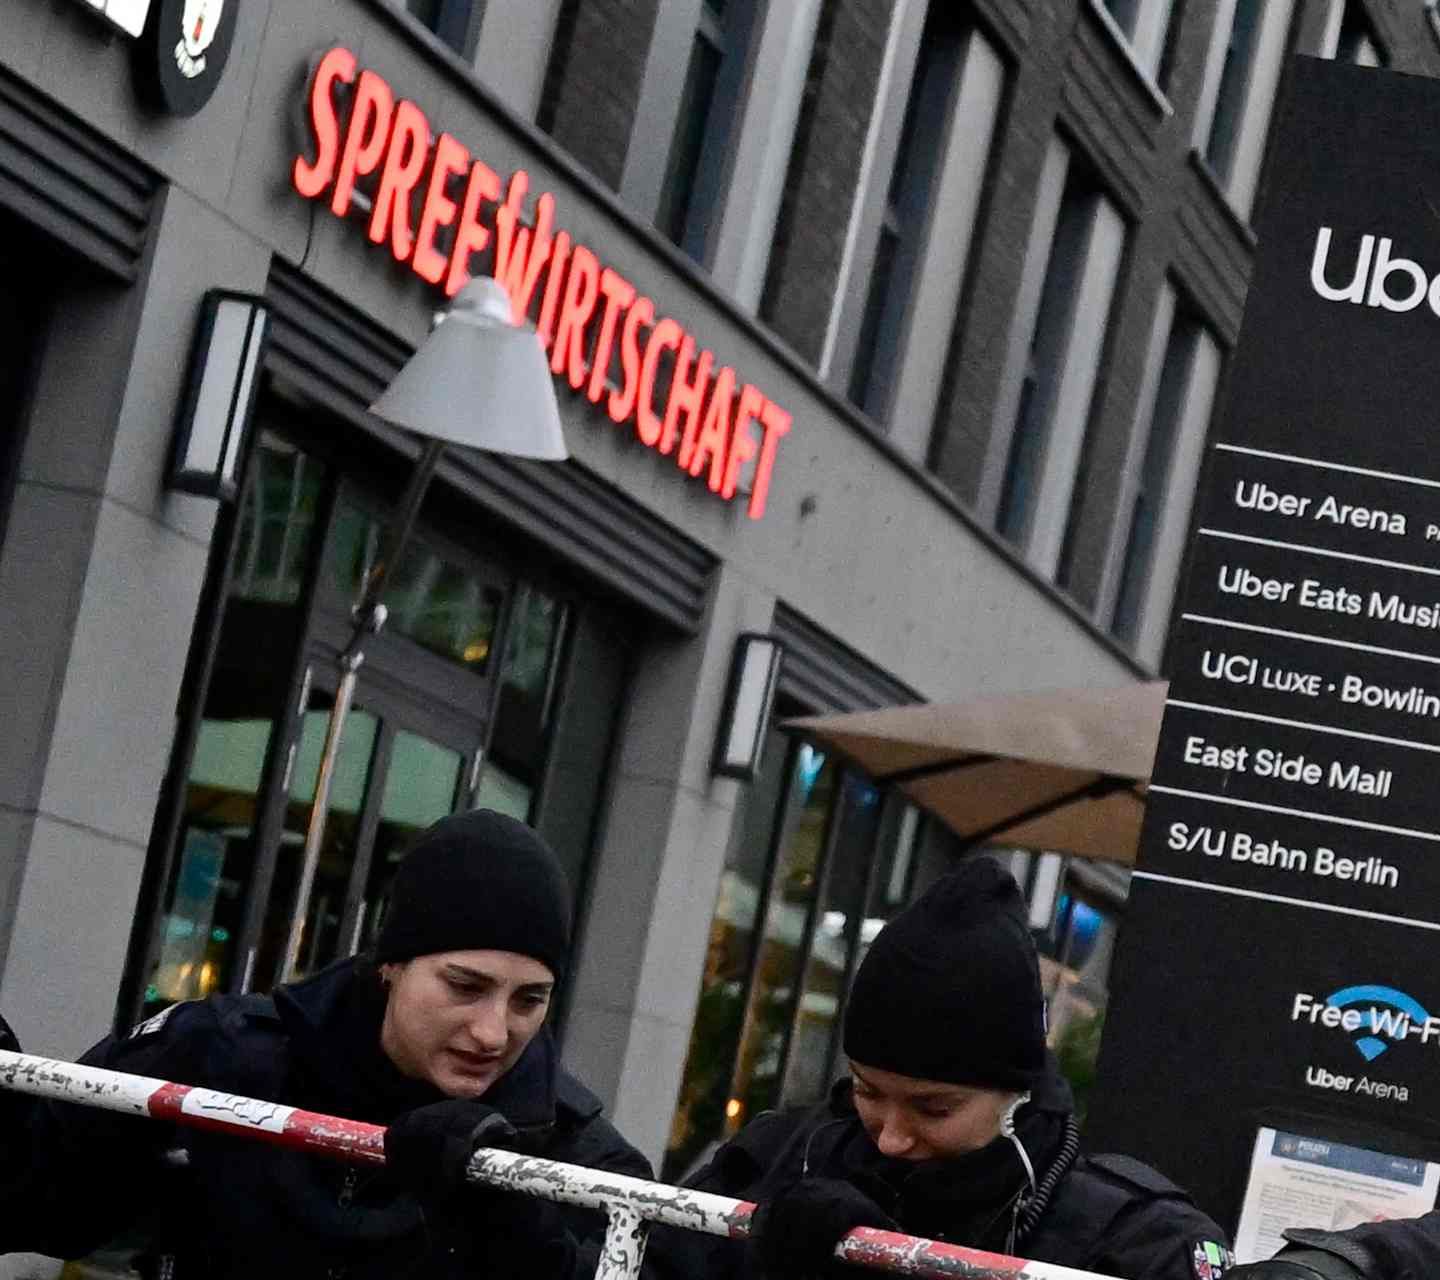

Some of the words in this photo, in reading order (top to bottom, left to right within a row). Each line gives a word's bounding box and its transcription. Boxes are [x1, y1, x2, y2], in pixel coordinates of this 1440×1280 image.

[1235, 480, 1312, 518] Uber
[1314, 495, 1407, 536] Arena
[1217, 565, 1295, 603] Uber
[1299, 579, 1363, 616] Eats
[1201, 650, 1259, 686] UCI
[1261, 667, 1323, 697] LUXE
[1183, 735, 1249, 773] East
[1253, 748, 1323, 785] Side
[1328, 761, 1393, 798] Mall
[1167, 822, 1227, 857] S/U
[1230, 832, 1308, 872] Bahn
[1312, 847, 1400, 889] Berlin
[1291, 993, 1362, 1032] Free
[1305, 1065, 1354, 1092] Uber
[1354, 1076, 1409, 1101] Arena
